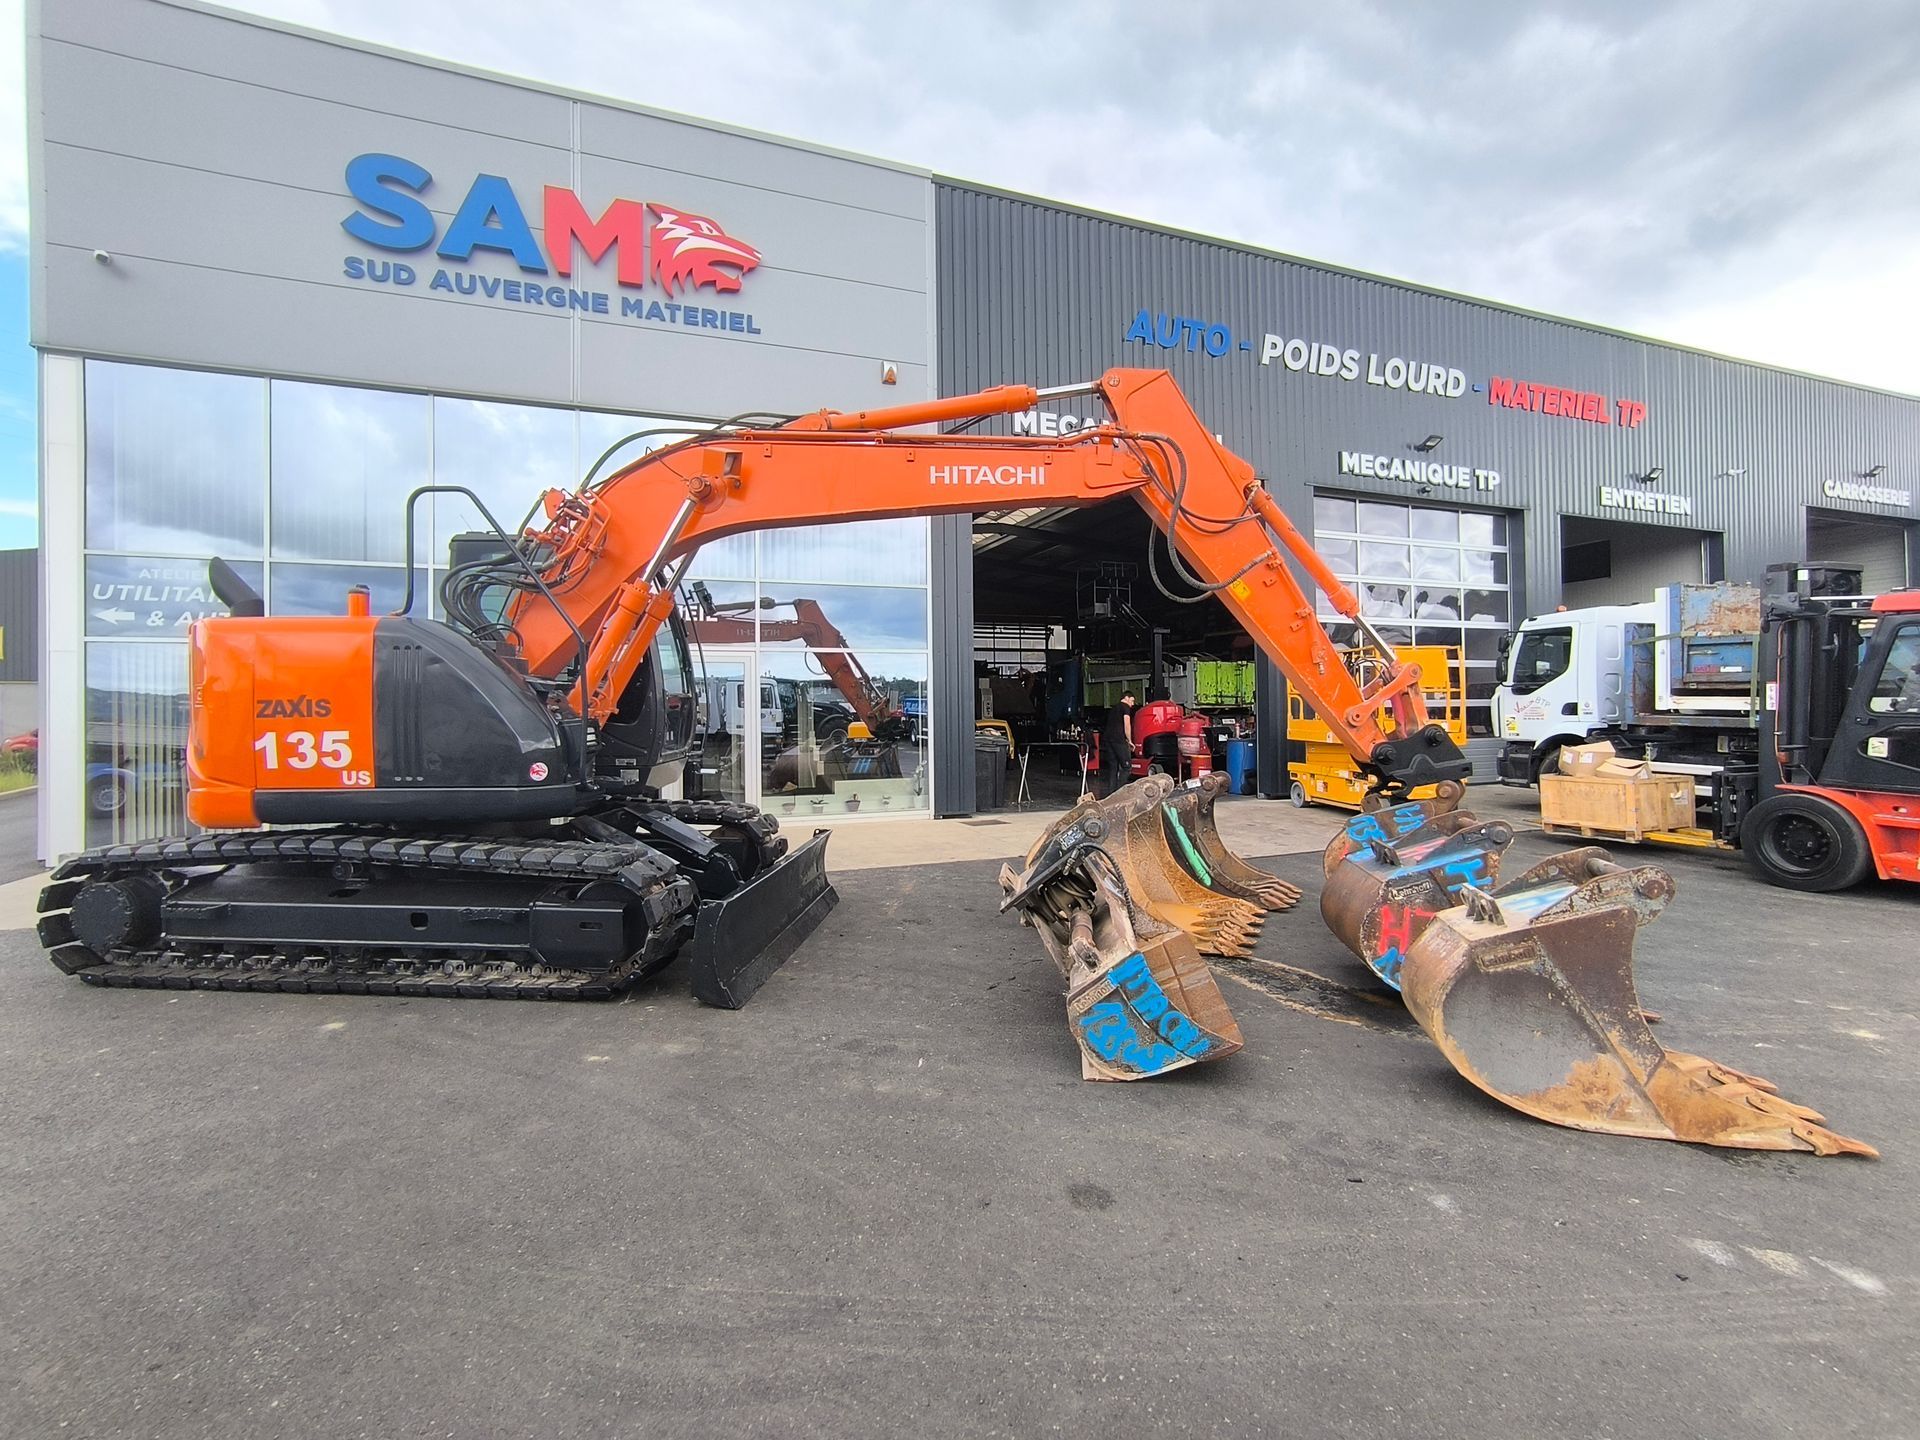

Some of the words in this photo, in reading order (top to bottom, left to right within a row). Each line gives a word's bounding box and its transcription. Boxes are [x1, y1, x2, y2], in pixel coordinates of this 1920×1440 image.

[341, 153, 643, 289] SAM
[343, 256, 416, 286] SUD
[430, 269, 609, 314] AUVERGNE
[621, 296, 761, 334] MATERIEL
[1125, 309, 1232, 357] AUTO
[1261, 333, 1360, 381] POIDS
[1367, 353, 1466, 398] LOURD
[1489, 376, 1611, 424] MATERIEL
[1617, 399, 1646, 429] TP
[929, 465, 1045, 485] HITACHI
[1340, 451, 1471, 489] MECANIQUE
[1473, 468, 1500, 491] TP
[1600, 486, 1692, 515] ENTRETIEN
[1823, 480, 1910, 508] CARROSSERIE
[145, 609, 165, 627] &
[256, 694, 332, 718] ZAXIS
[254, 730, 352, 769] 135
[342, 770, 371, 785] US
